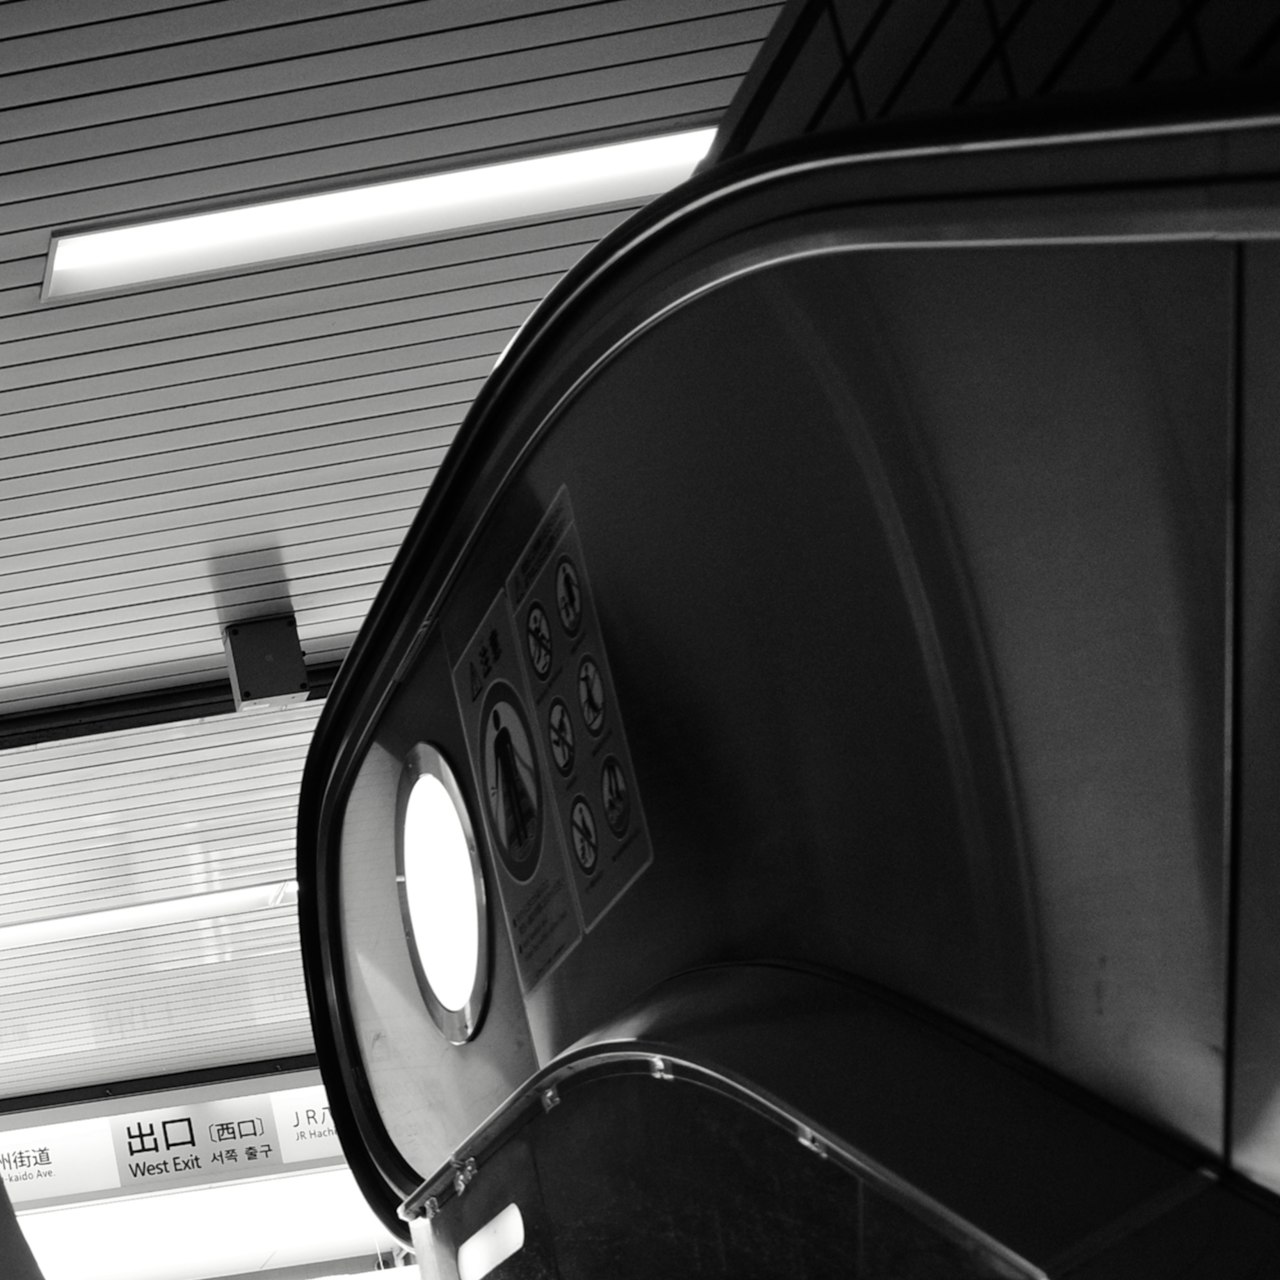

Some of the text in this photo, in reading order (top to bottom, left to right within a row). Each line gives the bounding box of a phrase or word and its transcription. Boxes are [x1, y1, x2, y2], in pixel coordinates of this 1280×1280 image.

[126, 1117, 196, 1157] 出口
[296, 1131, 307, 1141] JR
[210, 1144, 273, 1165] 서쪽 출구
[36, 1170, 56, 1179] Ave.
[128, 1154, 203, 1178] West Exit
